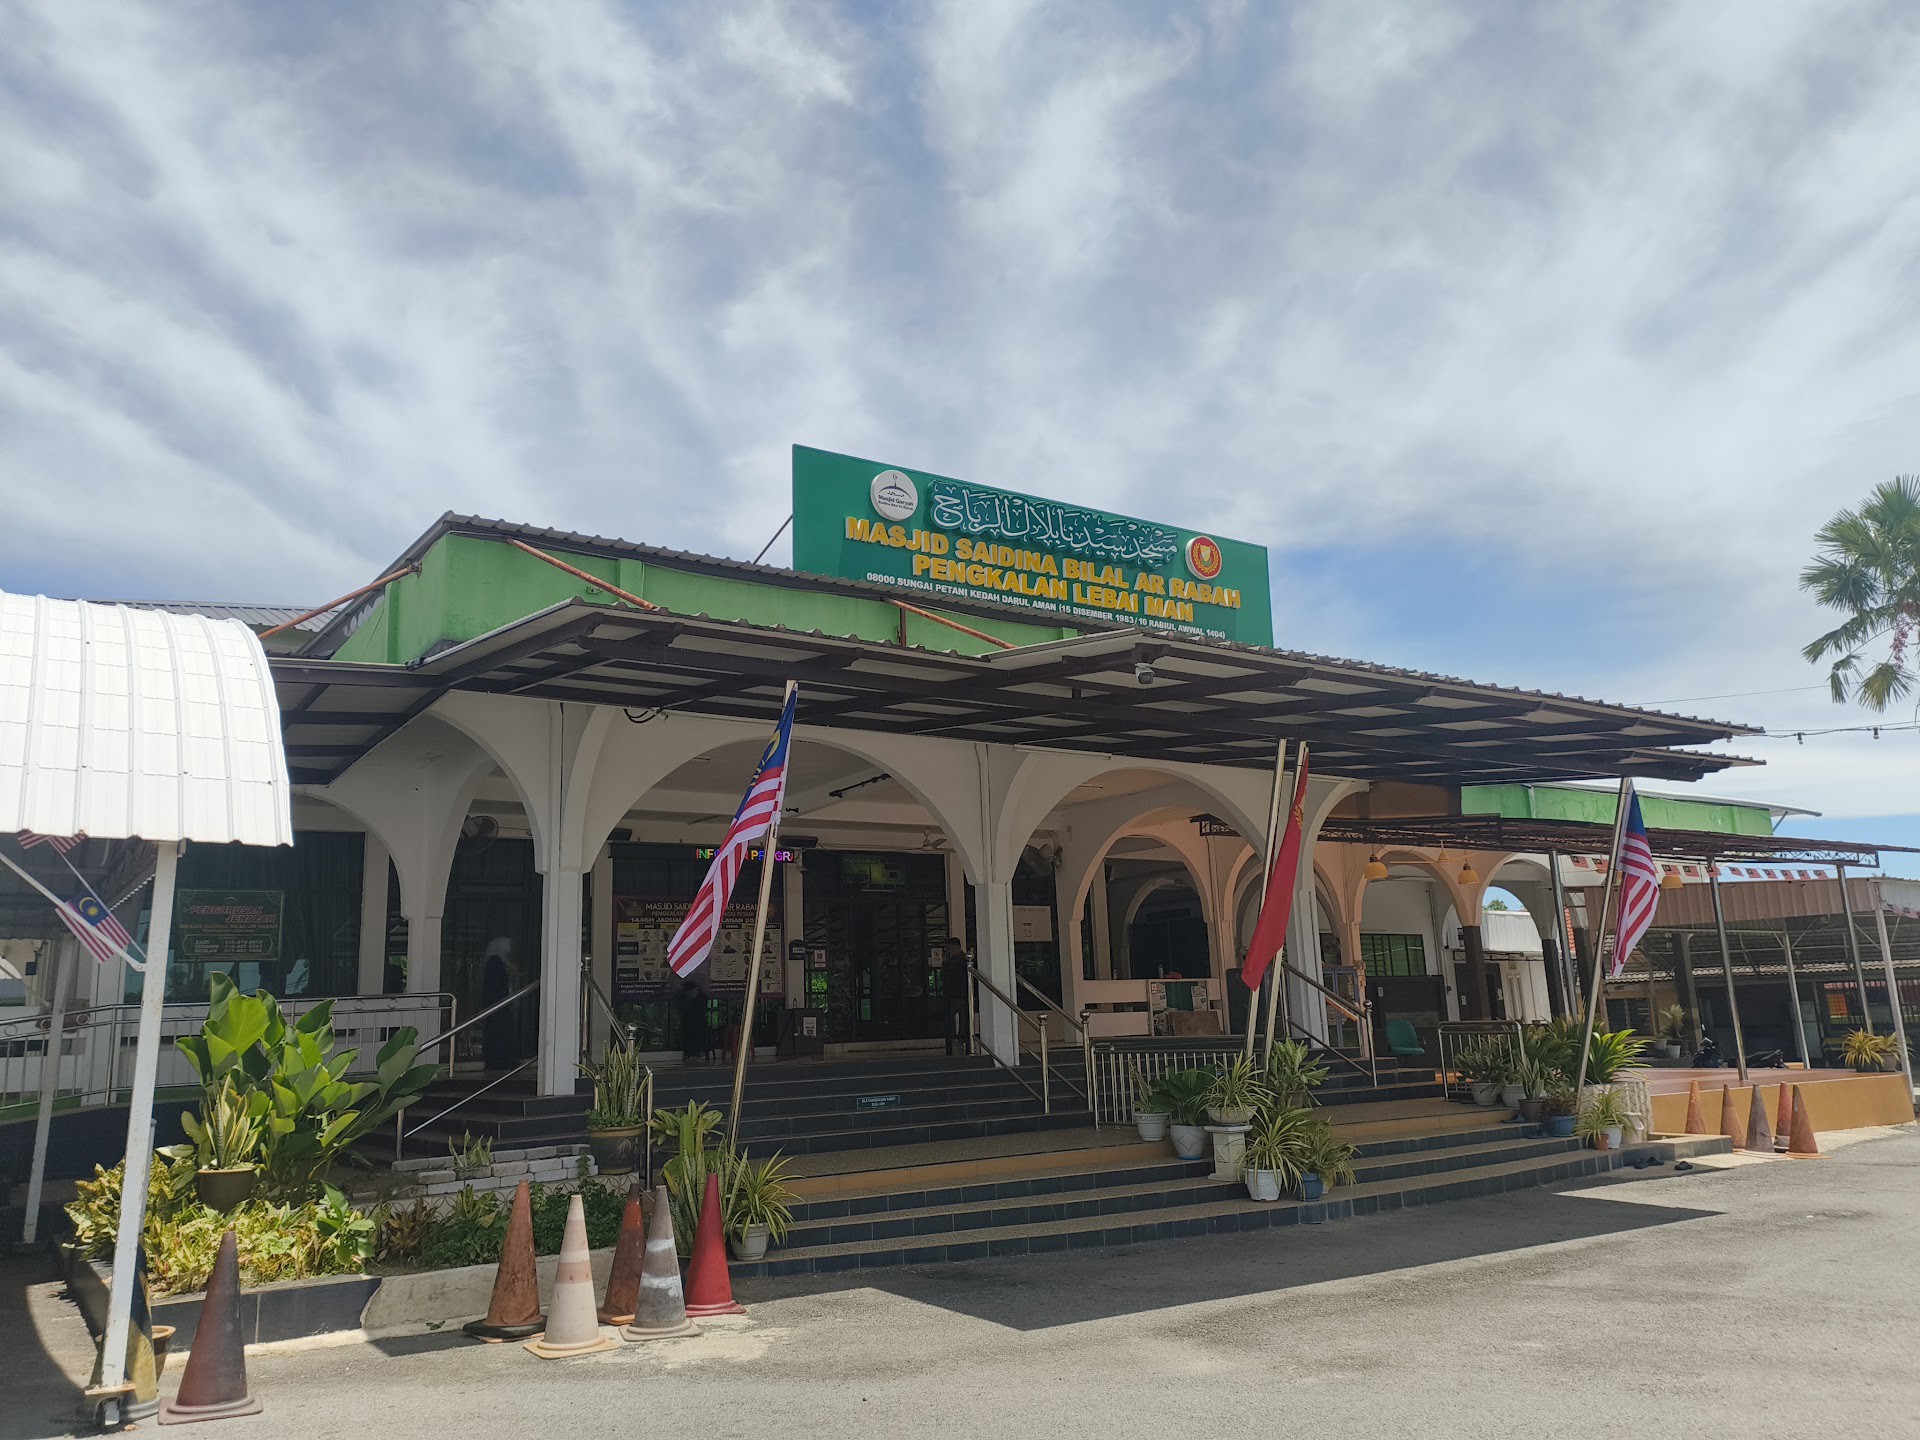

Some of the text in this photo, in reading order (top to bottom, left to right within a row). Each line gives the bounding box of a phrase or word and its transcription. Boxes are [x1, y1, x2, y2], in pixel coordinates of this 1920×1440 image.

[878, 494, 895, 503] Masjid
[846, 516, 1241, 609] MASJID SAIDINA BILAL AR RABAH
[912, 554, 1194, 622] PENGKALAN LEBAI MAN
[866, 572, 896, 585] 08000
[897, 577, 933, 591] SUNGAI
[935, 584, 968, 597] PETANI
[969, 589, 1000, 602] KEDAH
[1001, 594, 1031, 607] DARUL
[1032, 600, 1057, 612] AMAN
[1058, 604, 1072, 614] (15
[1073, 607, 1113, 620] DISEMBER
[1148, 619, 1177, 631] RABIUL
[1178, 624, 1205, 636] AWWAL
[1206, 629, 1226, 640] 1404)
[190, 905, 264, 915] PENGURUSAN
[645, 902, 673, 911] MASJID
[224, 914, 277, 924] JENAZAH
